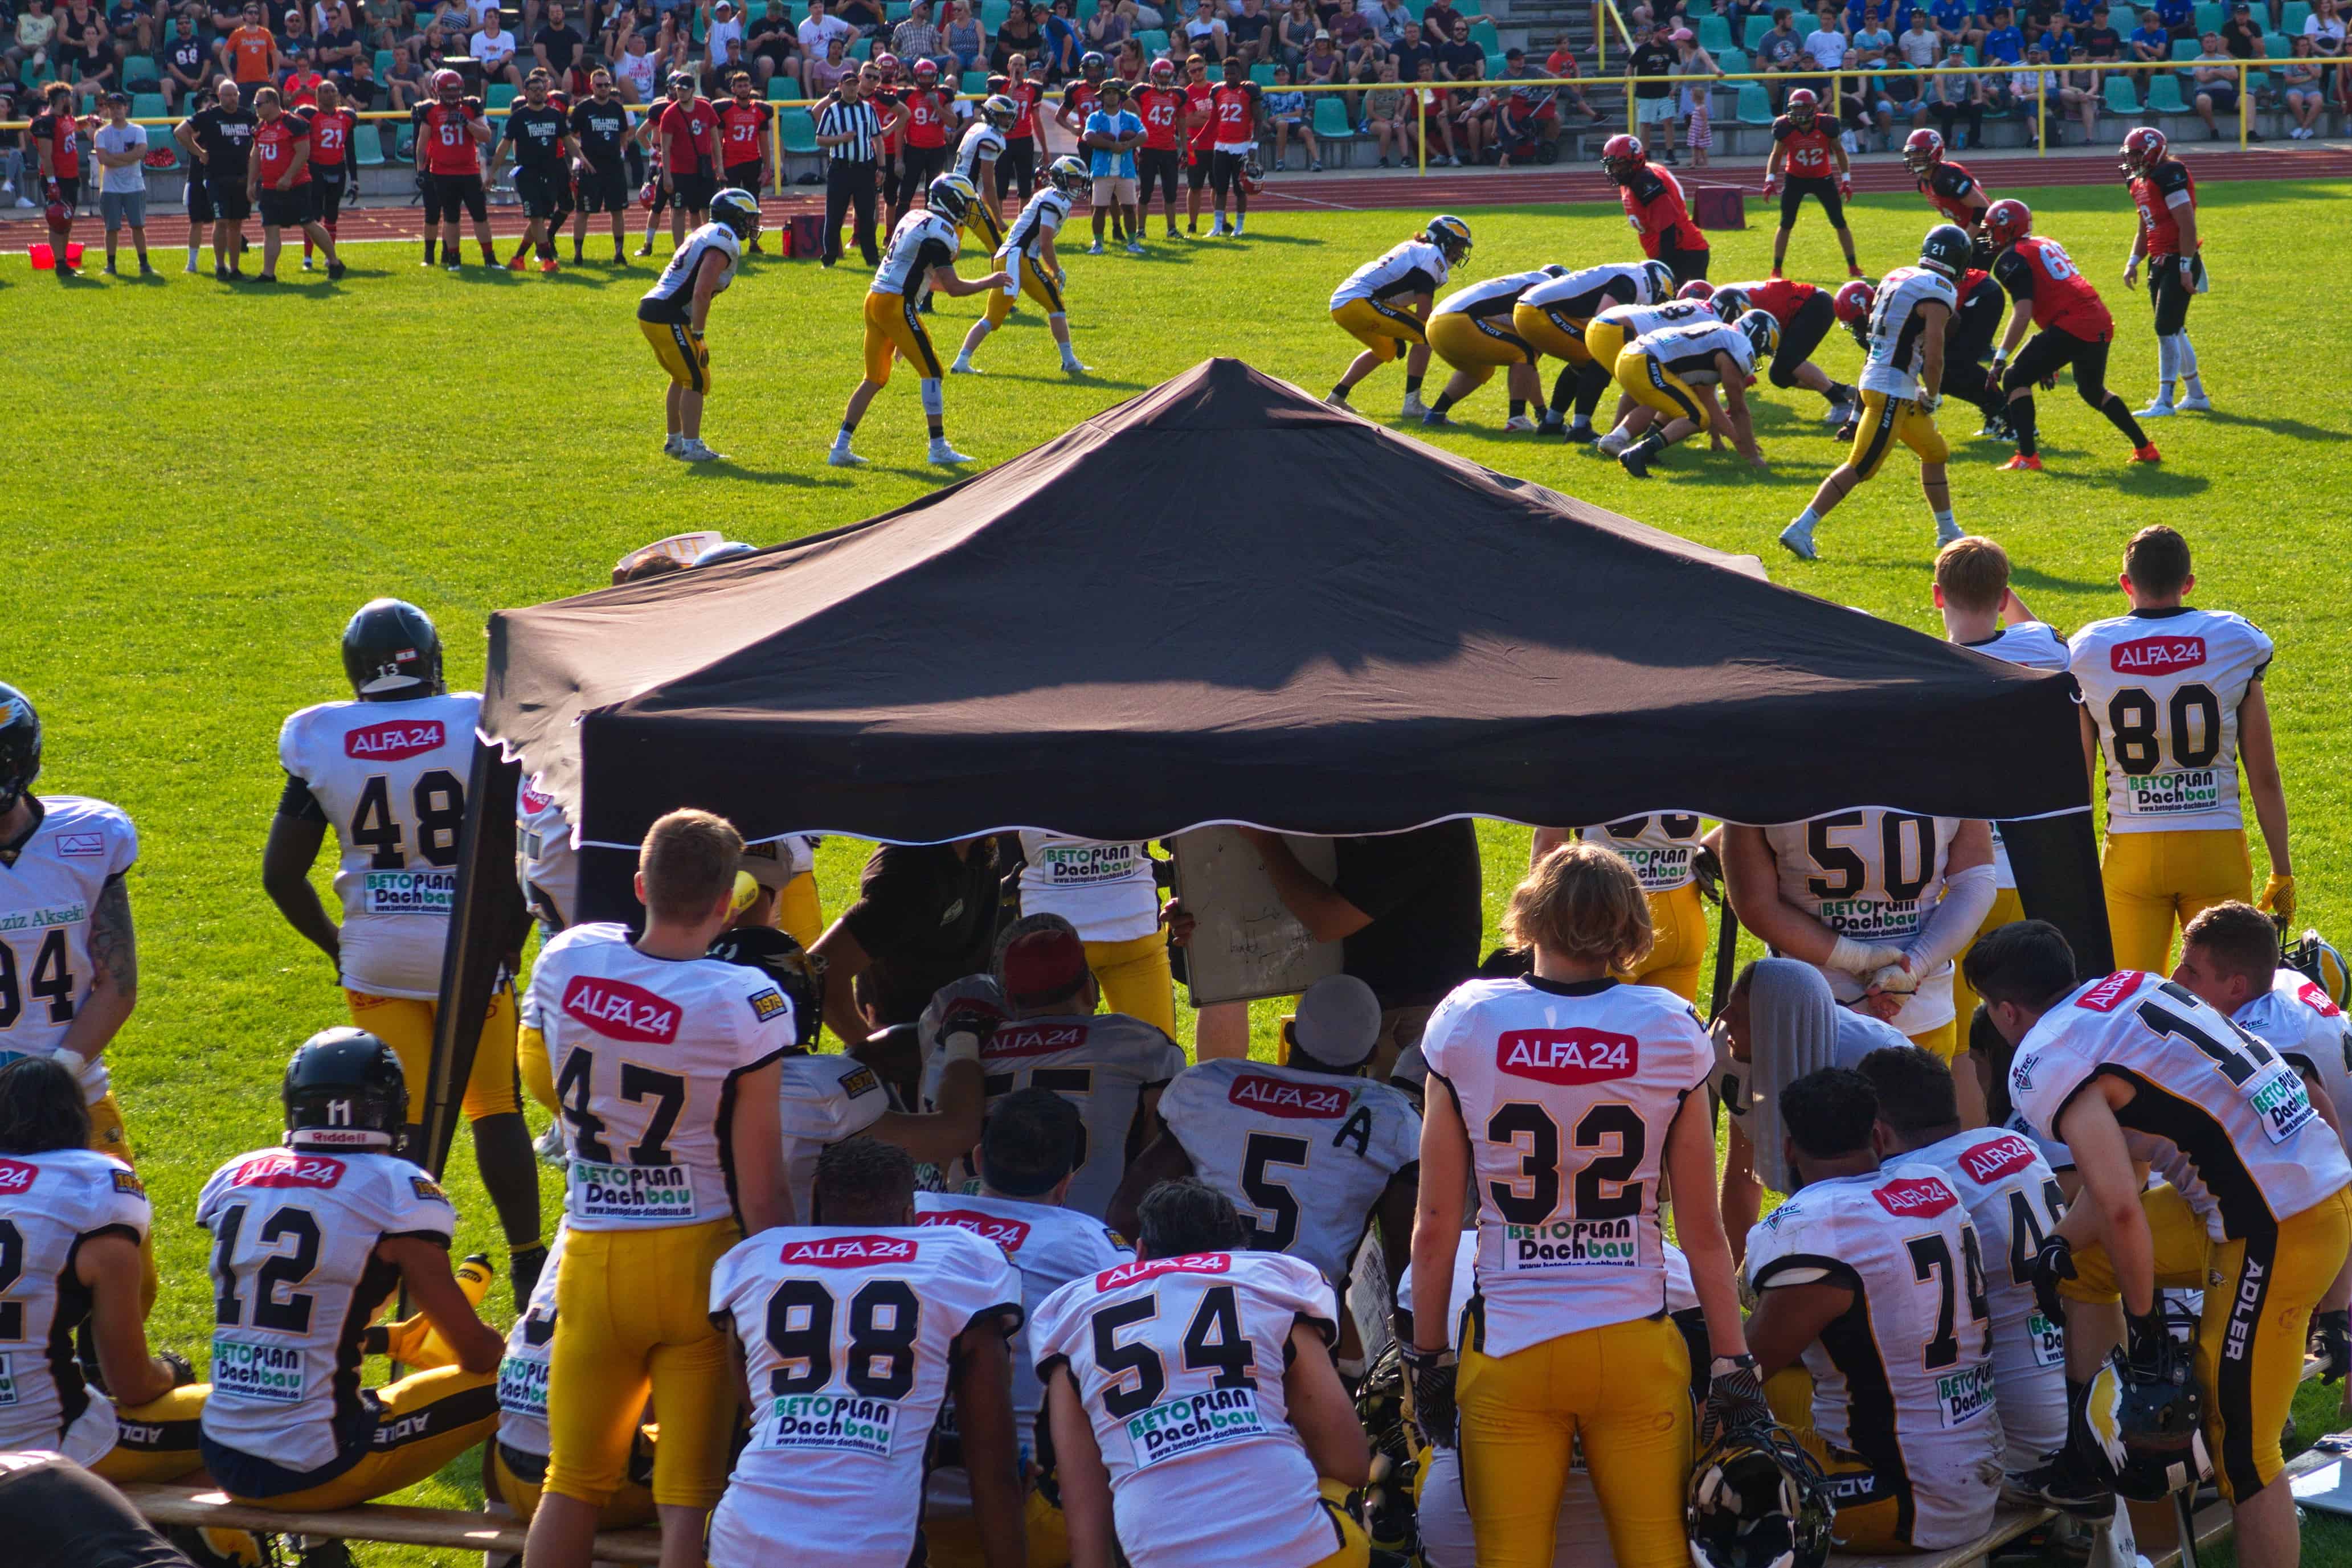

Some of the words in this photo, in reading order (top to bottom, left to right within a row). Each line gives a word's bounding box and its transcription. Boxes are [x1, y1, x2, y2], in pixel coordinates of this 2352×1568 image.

[914, 107, 940, 125] 94
[1148, 105, 1175, 126] 43
[1219, 103, 1242, 122] 22
[321, 129, 342, 149] 21
[440, 123, 464, 146] 61
[1795, 148, 1823, 166] 42
[916, 218, 933, 230] A
[1931, 243, 1946, 256] 21
[377, 663, 399, 678] 13
[2106, 681, 2221, 775] 80
[2129, 771, 2214, 791] BETOPLAN
[2138, 787, 2216, 804] Dachbau
[350, 767, 466, 870] 48
[1046, 846, 1130, 863] BETOPLAN
[1054, 858, 1134, 876] Dachbau
[1804, 811, 1938, 901] 50
[1832, 912, 1917, 931] Dachbau
[756, 993, 784, 1014] 1979
[2014, 1057, 2032, 1090] DIATEC
[326, 1099, 351, 1127] 11
[553, 1045, 690, 1165] 47
[312, 1132, 367, 1145] Riddell
[1332, 1106, 1372, 1158] A
[1484, 1099, 1647, 1225] 32
[575, 1164, 683, 1186] BETOPLAN
[585, 1183, 690, 1205] Dachbau
[1237, 1129, 1313, 1253] 5
[1507, 1219, 1631, 1240] BETOPLAN
[1518, 1239, 1634, 1260] Dachbau
[214, 1203, 324, 1338] 12
[1903, 1221, 1994, 1373] 74
[2224, 1256, 2265, 1362] ADLER
[763, 1276, 923, 1402] 98
[1089, 1283, 1262, 1423] 54
[218, 1360, 301, 1389] Dachbau
[774, 1396, 890, 1425] BETOPLAN
[1130, 1388, 1250, 1442] BETOPLAN
[778, 1416, 890, 1444] Dachbau
[1143, 1408, 1260, 1452] Dachbau
[1149, 1424, 1263, 1461] www.betoplan-dachbau.de
